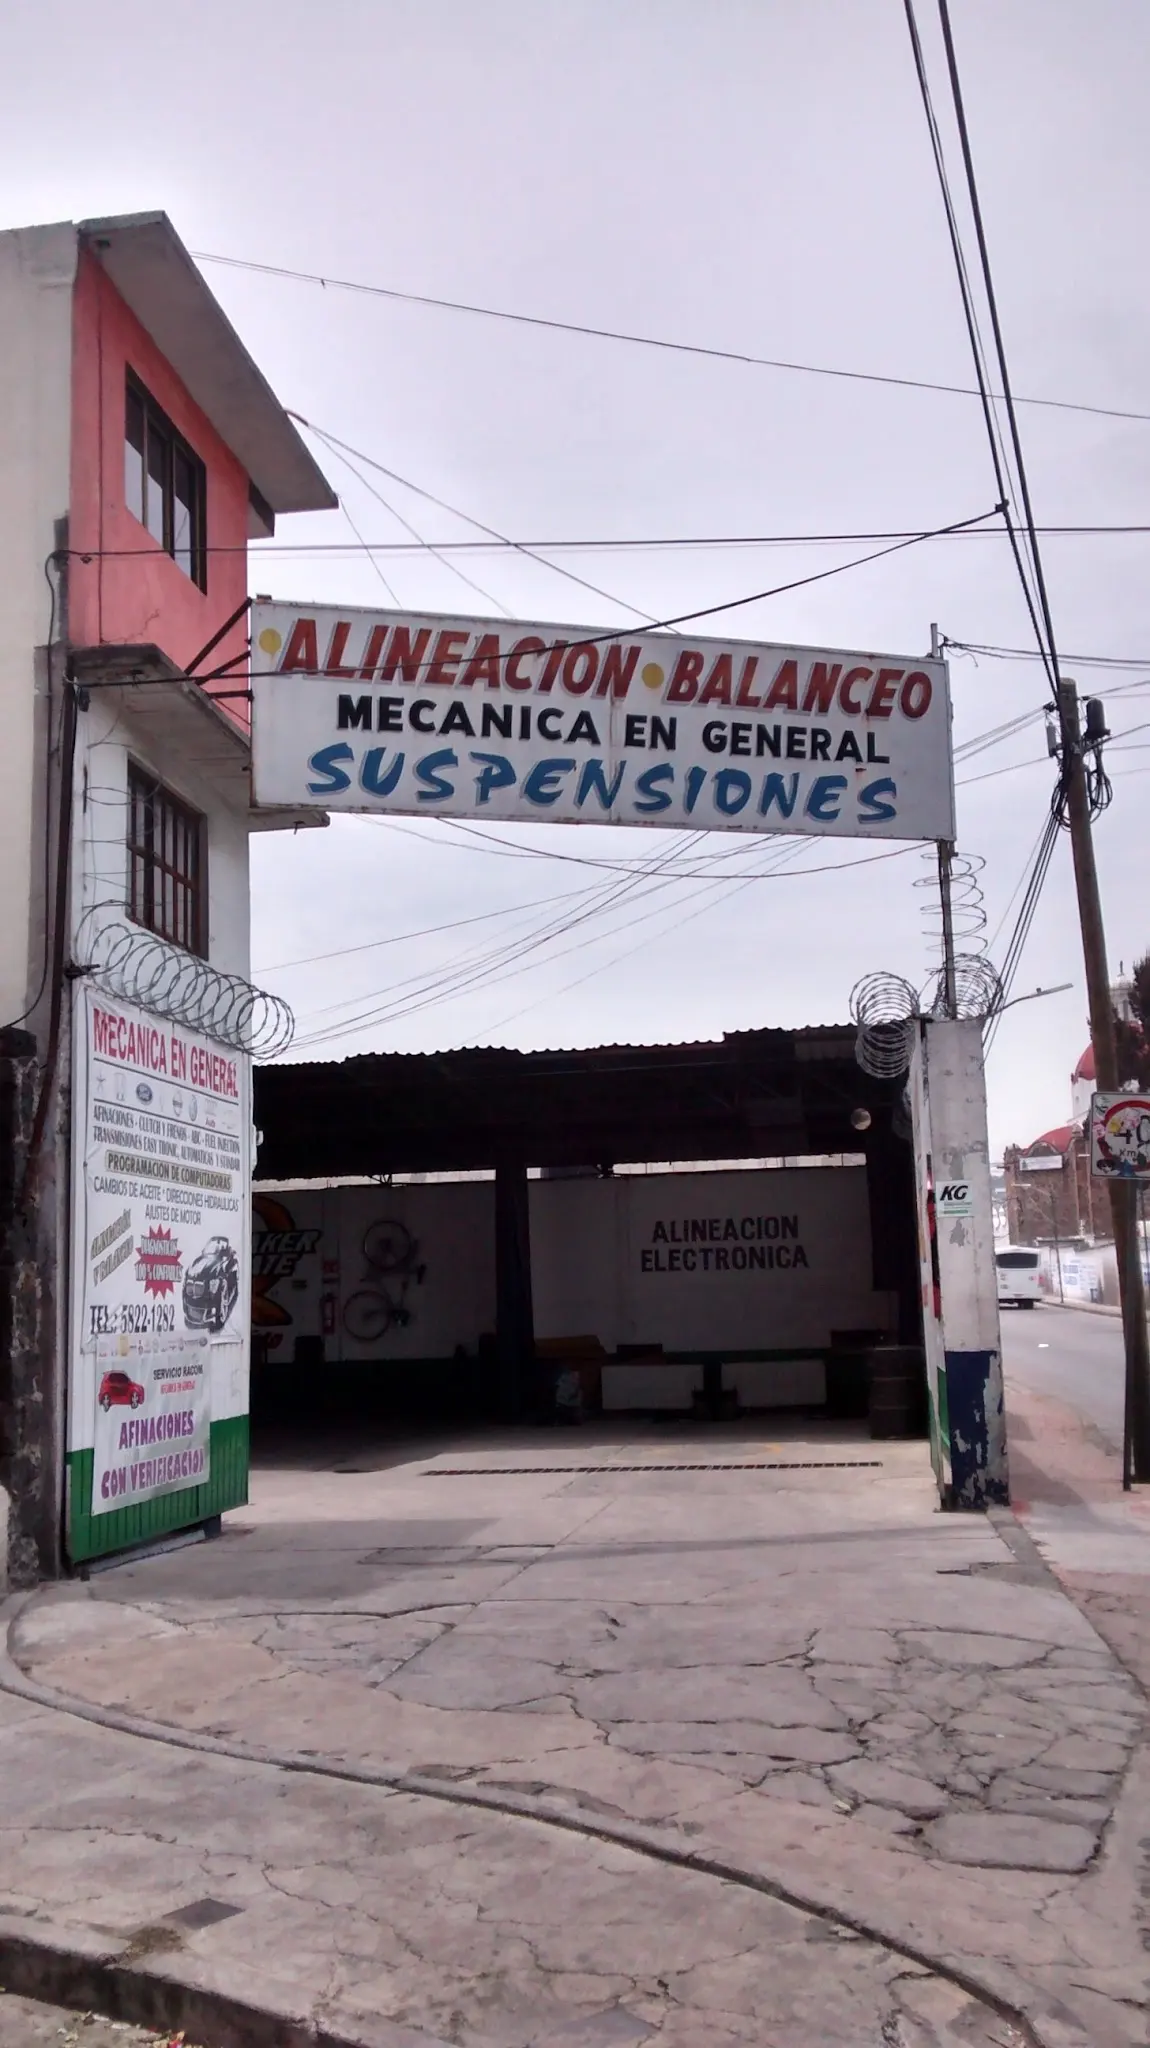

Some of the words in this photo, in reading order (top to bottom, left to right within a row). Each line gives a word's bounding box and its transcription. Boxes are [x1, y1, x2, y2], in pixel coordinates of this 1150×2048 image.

[277, 618, 641, 699] ALINEACION
[663, 651, 932, 720] BALANCEO
[337, 694, 600, 746] MECANICA
[625, 714, 677, 751] EN
[702, 719, 890, 765] GENERAL
[306, 743, 898, 823] SUSPENSIONES
[93, 1007, 167, 1074] MECANICA
[171, 1037, 186, 1080] EN
[190, 1046, 239, 1098] GENERAL
[93, 1104, 135, 1128] AFINACIONES
[93, 1125, 142, 1150] TRANSMISIONES
[144, 1136, 157, 1153] EASY
[107, 1152, 170, 1181] PROGRAMACION
[171, 1167, 180, 1181] DE
[181, 1168, 231, 1191] COMPUTADORAS
[93, 1176, 128, 1197] CAMBIOS
[128, 1182, 138, 1198] DE
[139, 1184, 162, 1201] ACEITE
[166, 1187, 204, 1208] DIRECCIONES
[940, 1185, 969, 1201] KG
[145, 1204, 170, 1221] AJUSTES
[170, 1208, 180, 1222] DE
[180, 1209, 201, 1225] MOTOR
[652, 1215, 799, 1243] ALINEACION
[640, 1245, 810, 1273] ELECTRONICA
[121, 1304, 175, 1333] 5822-1282
[153, 1366, 182, 1380] SERVICIO
[119, 1409, 194, 1450] AFINACIONES
[101, 1467, 126, 1499] CON
